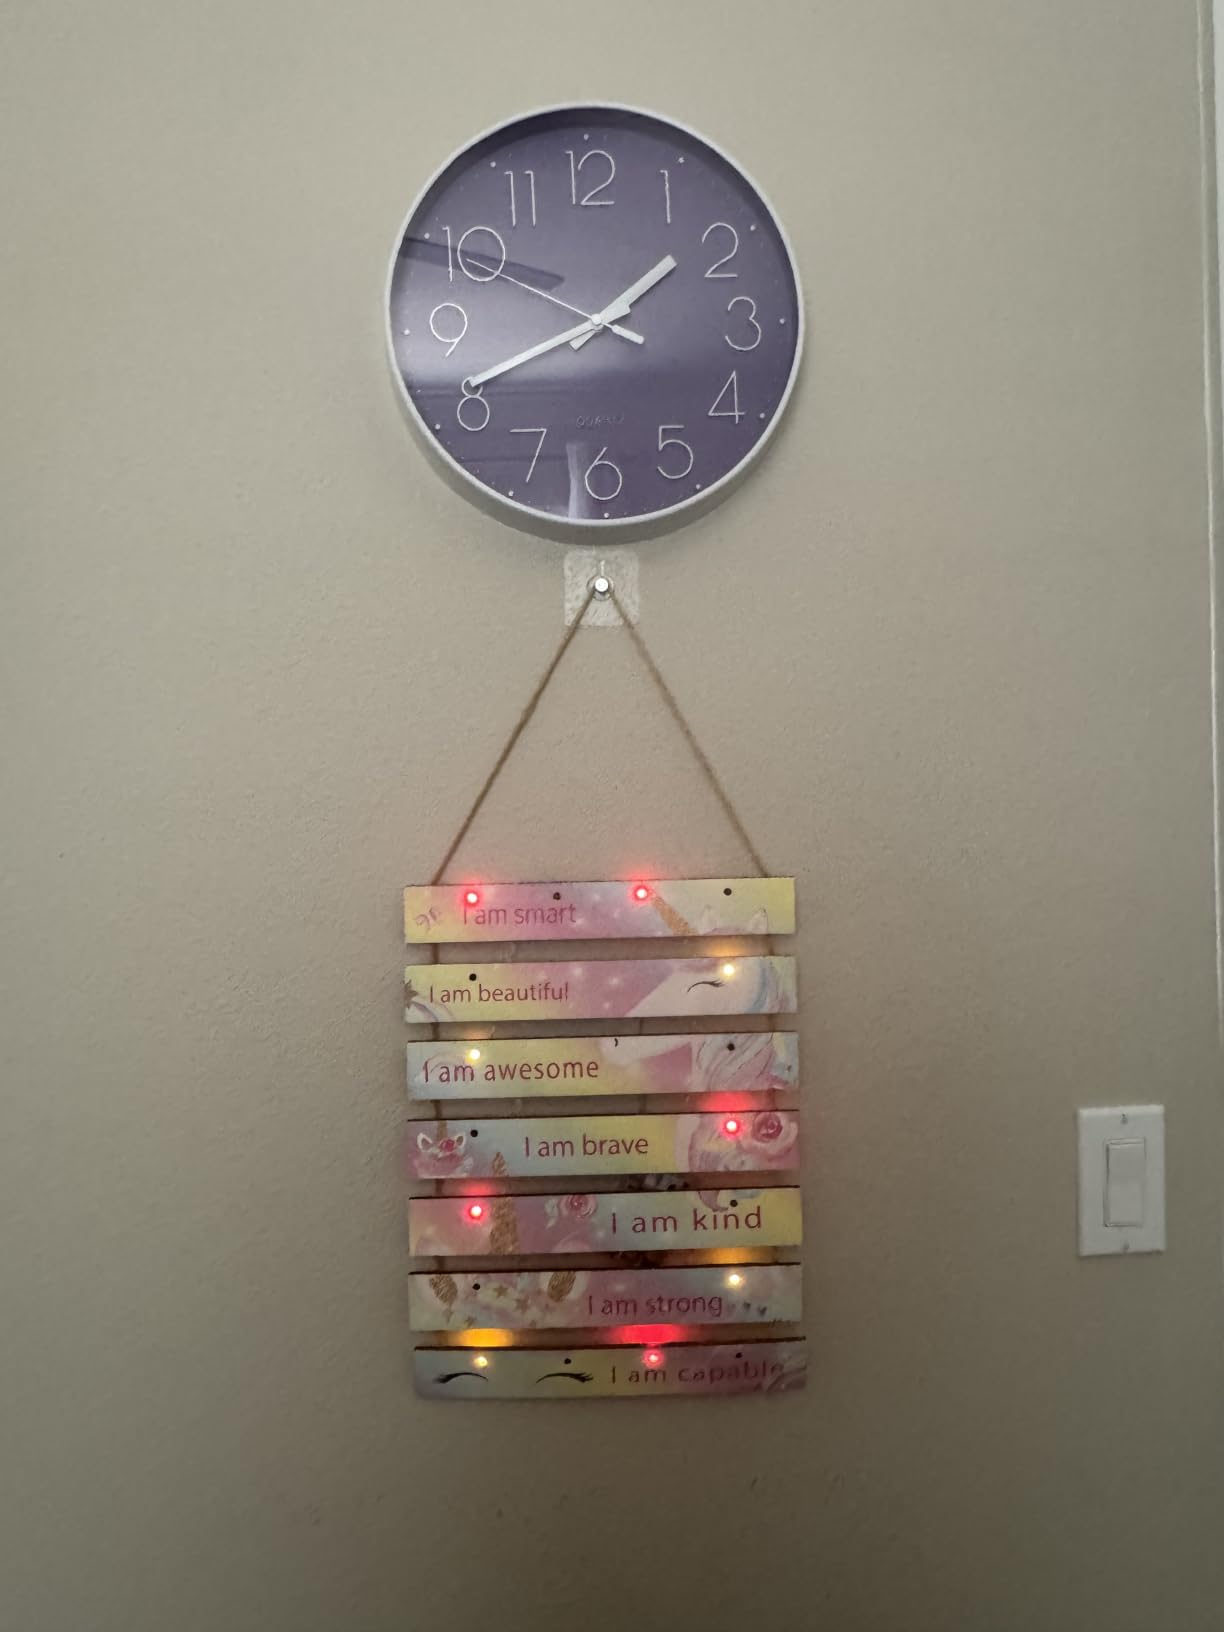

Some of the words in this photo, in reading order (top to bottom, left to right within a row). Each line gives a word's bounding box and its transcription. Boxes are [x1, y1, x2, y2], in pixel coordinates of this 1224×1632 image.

[504, 170, 536, 227] 11
[565, 150, 615, 206] 12
[660, 169, 671, 224] 1
[442, 226, 506, 282] 10
[701, 222, 739, 278] 2
[429, 302, 468, 357] 9
[724, 296, 762, 351] 3
[456, 376, 490, 431] 8
[707, 370, 745, 424] 4
[509, 428, 547, 483] 7
[584, 446, 623, 501] 6
[656, 425, 694, 480] 5
[475, 908, 507, 926] am
[513, 903, 577, 925] smart
[440, 987, 471, 1004] am
[478, 981, 569, 1003] beautiful
[438, 1064, 475, 1083] am
[484, 1060, 600, 1081] awesome
[537, 1139, 575, 1157] am
[582, 1133, 649, 1156] brave
[631, 1214, 678, 1233] am
[692, 1205, 762, 1231] kind
[600, 1297, 638, 1315] am
[646, 1295, 723, 1318] strong
[628, 1367, 667, 1384] am
[678, 1358, 785, 1384] capable
